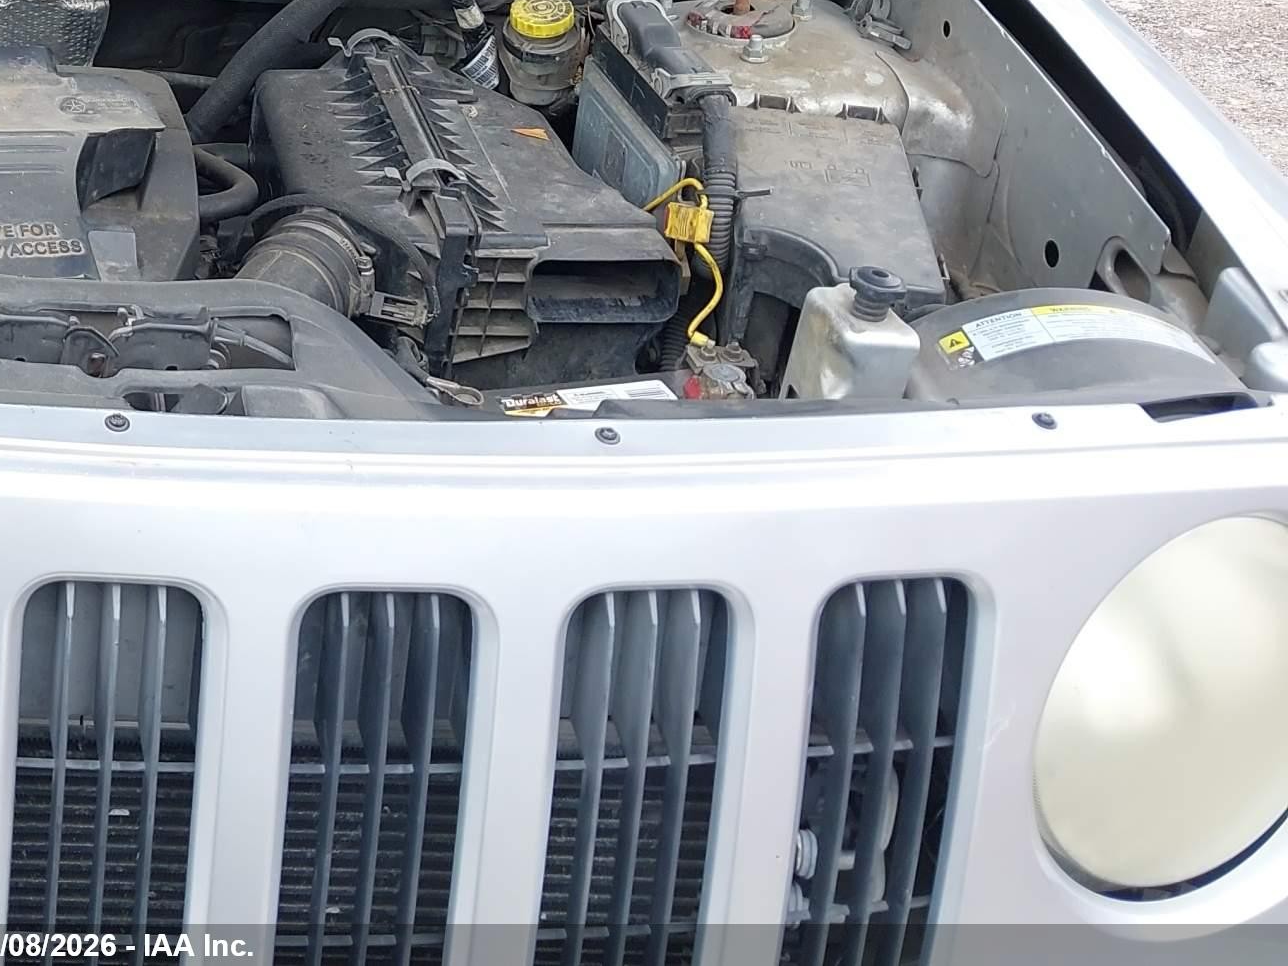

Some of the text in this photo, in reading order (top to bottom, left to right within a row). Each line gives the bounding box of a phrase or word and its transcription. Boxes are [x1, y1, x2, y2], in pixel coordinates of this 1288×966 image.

[19, 223, 57, 237] FOR
[10, 240, 83, 257] ACCESS
[976, 312, 1022, 327] ATTENTION
[501, 393, 562, 408] Duralast
